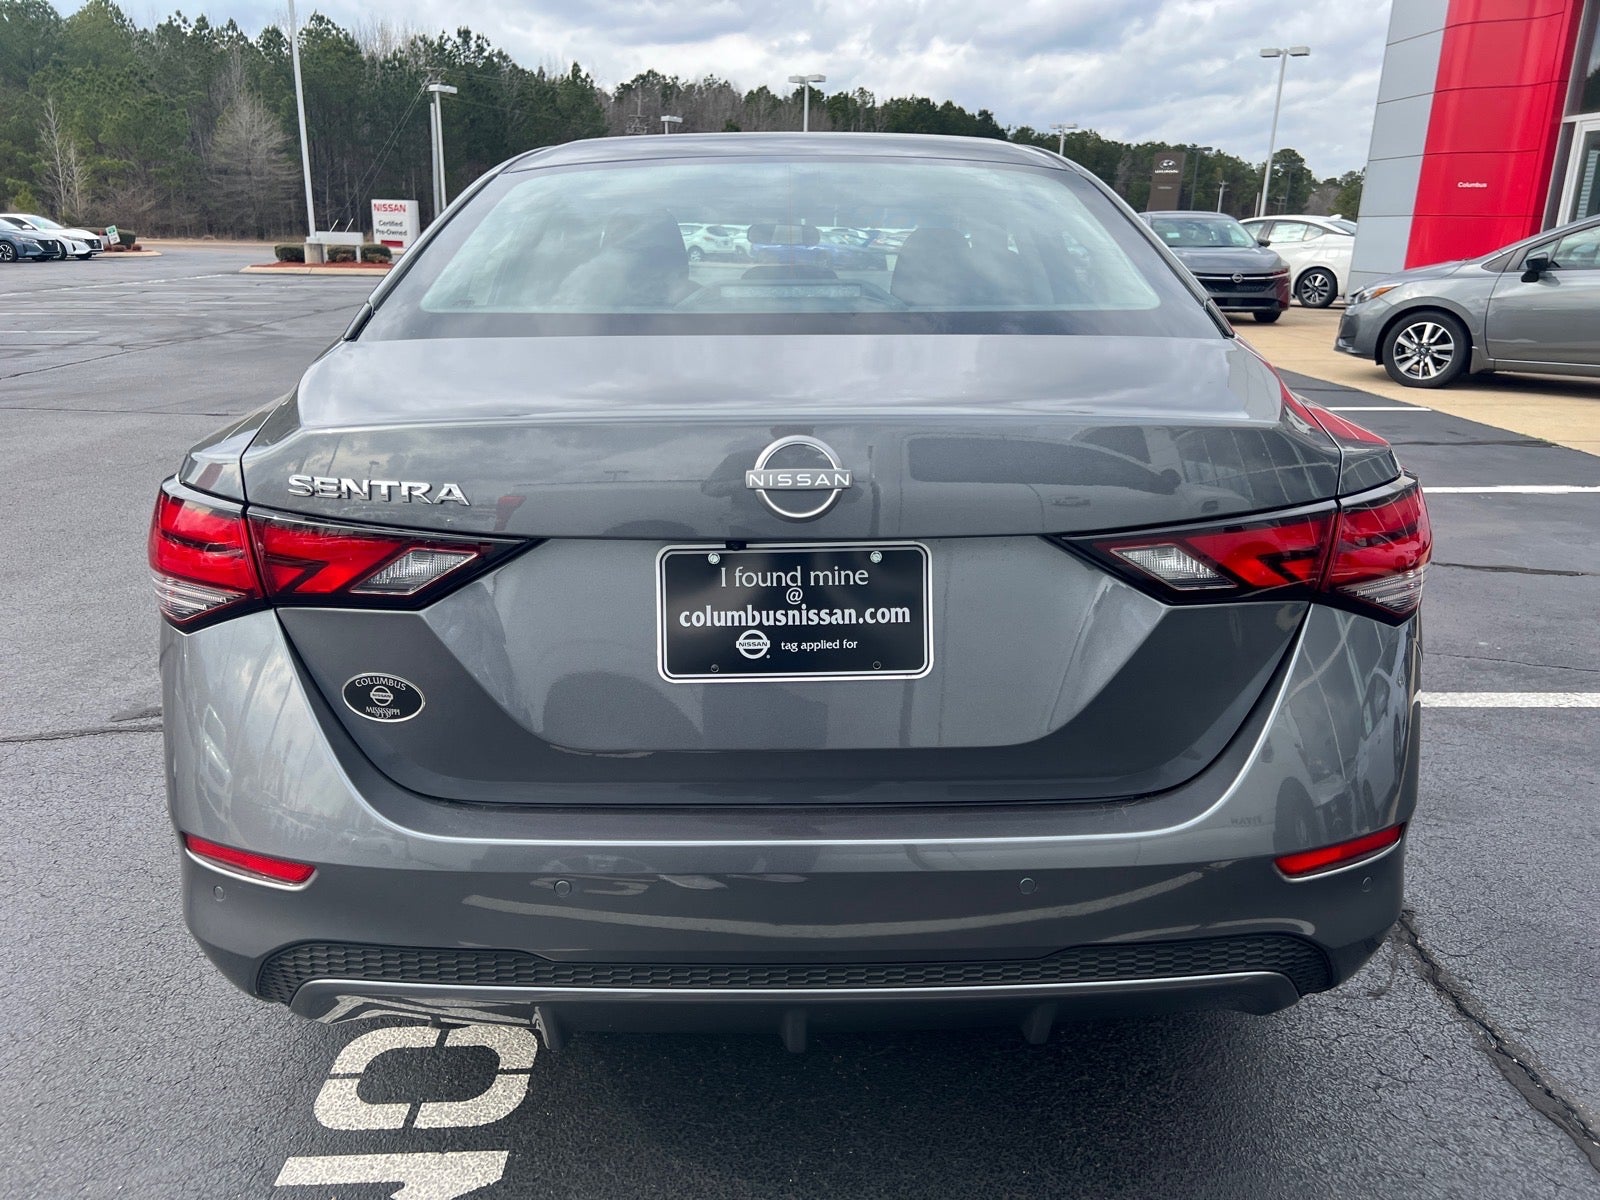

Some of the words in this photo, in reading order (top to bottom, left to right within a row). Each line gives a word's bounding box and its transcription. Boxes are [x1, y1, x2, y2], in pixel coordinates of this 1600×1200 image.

[373, 203, 407, 213] NISSAN
[749, 473, 850, 487] NISSAN
[288, 474, 471, 506] SENTRA
[720, 567, 727, 588] I
[734, 565, 802, 588] found
[809, 565, 869, 586] mine
[785, 587, 804, 605] @
[679, 604, 911, 627] columbusnissan.com
[780, 641, 799, 653] tag
[800, 639, 840, 652] applied
[842, 638, 858, 649] for
[355, 676, 407, 691] COLUMBUS
